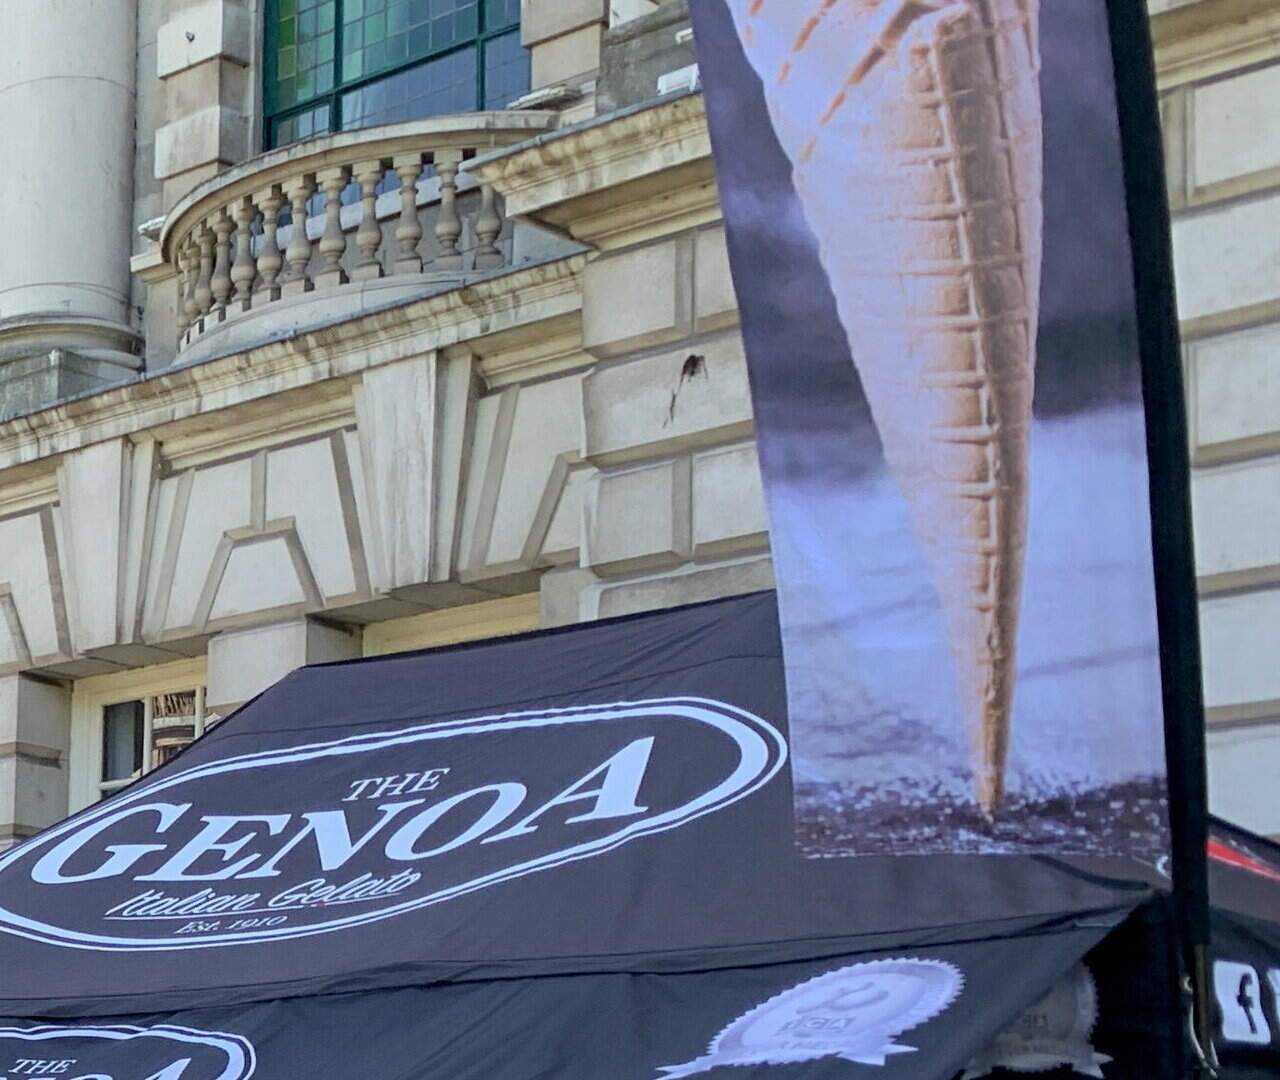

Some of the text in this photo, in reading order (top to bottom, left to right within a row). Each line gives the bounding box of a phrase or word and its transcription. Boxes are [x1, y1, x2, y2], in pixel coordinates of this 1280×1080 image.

[349, 767, 450, 801] THE
[30, 736, 657, 885] GENOA
[104, 868, 422, 917] Italian Gelato
[173, 915, 289, 935] Est. 1910
[8, 1058, 77, 1075] THE
